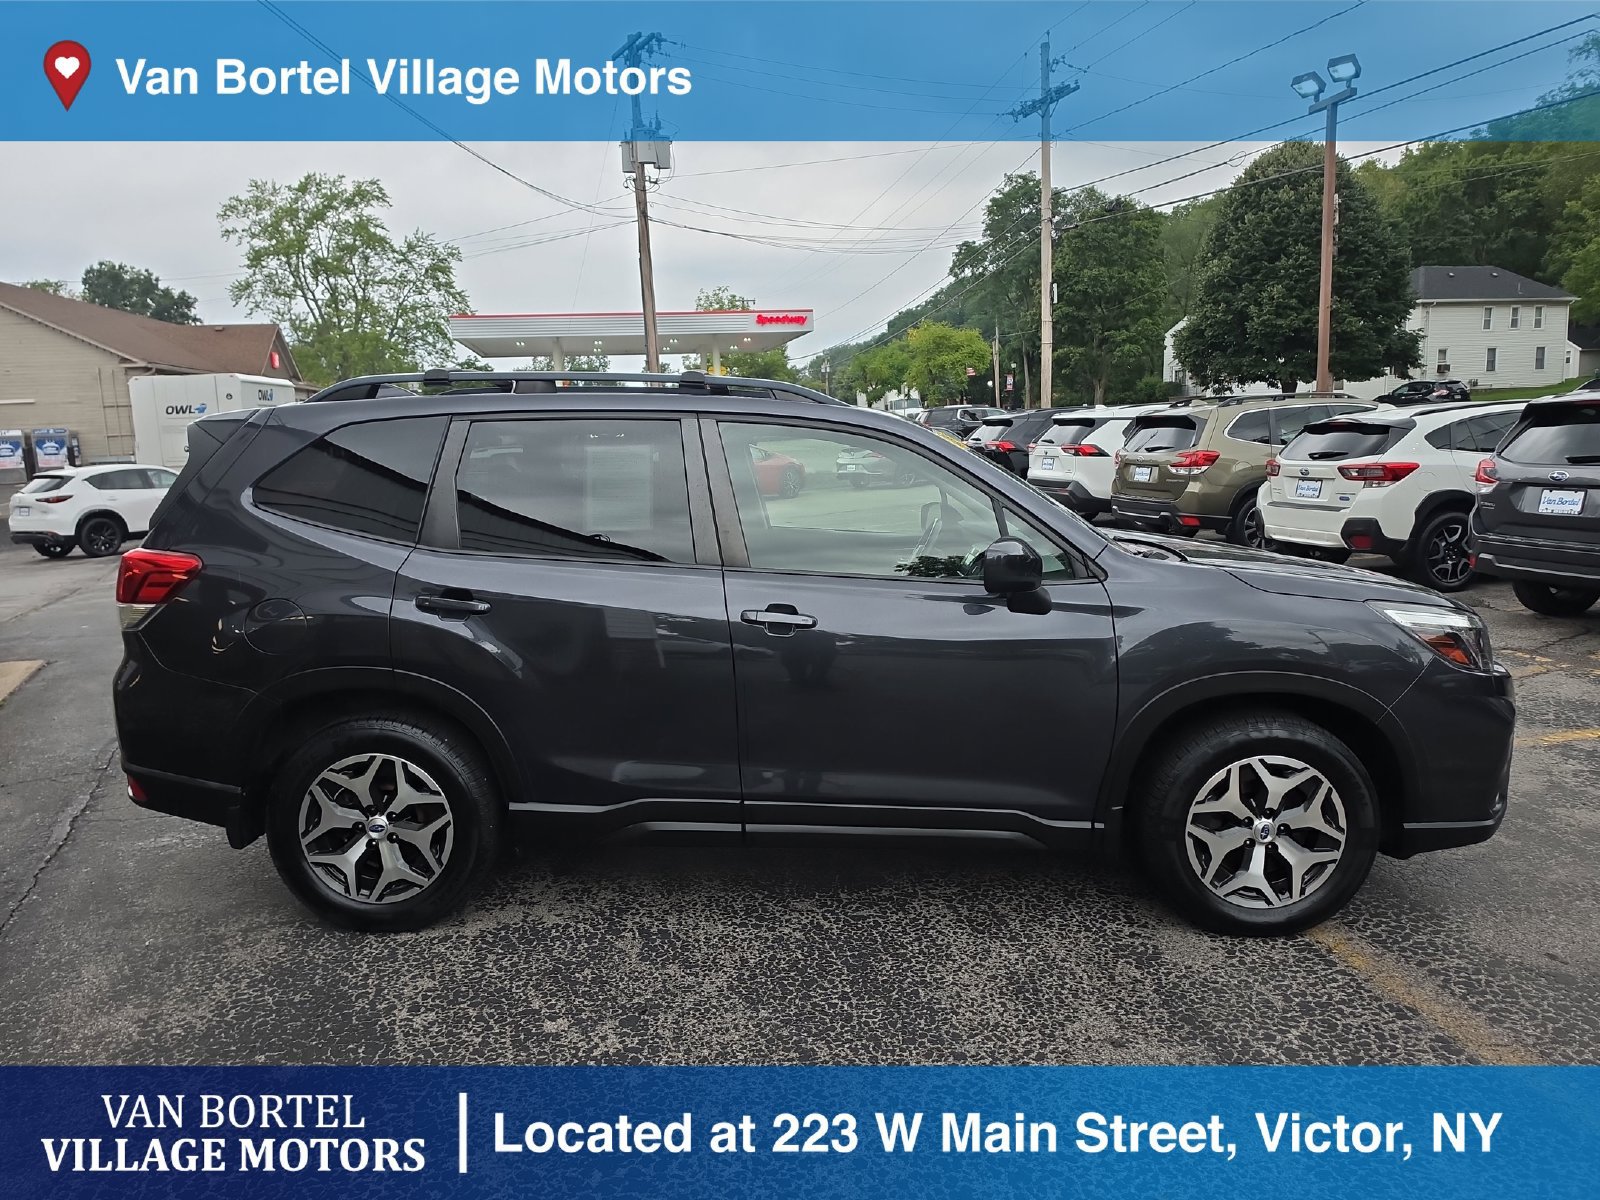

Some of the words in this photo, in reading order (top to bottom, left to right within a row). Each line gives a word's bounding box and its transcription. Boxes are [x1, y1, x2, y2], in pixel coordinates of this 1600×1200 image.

[756, 314, 808, 326] Speedway
[165, 405, 196, 415] OWL
[1542, 496, 1557, 505] Van
